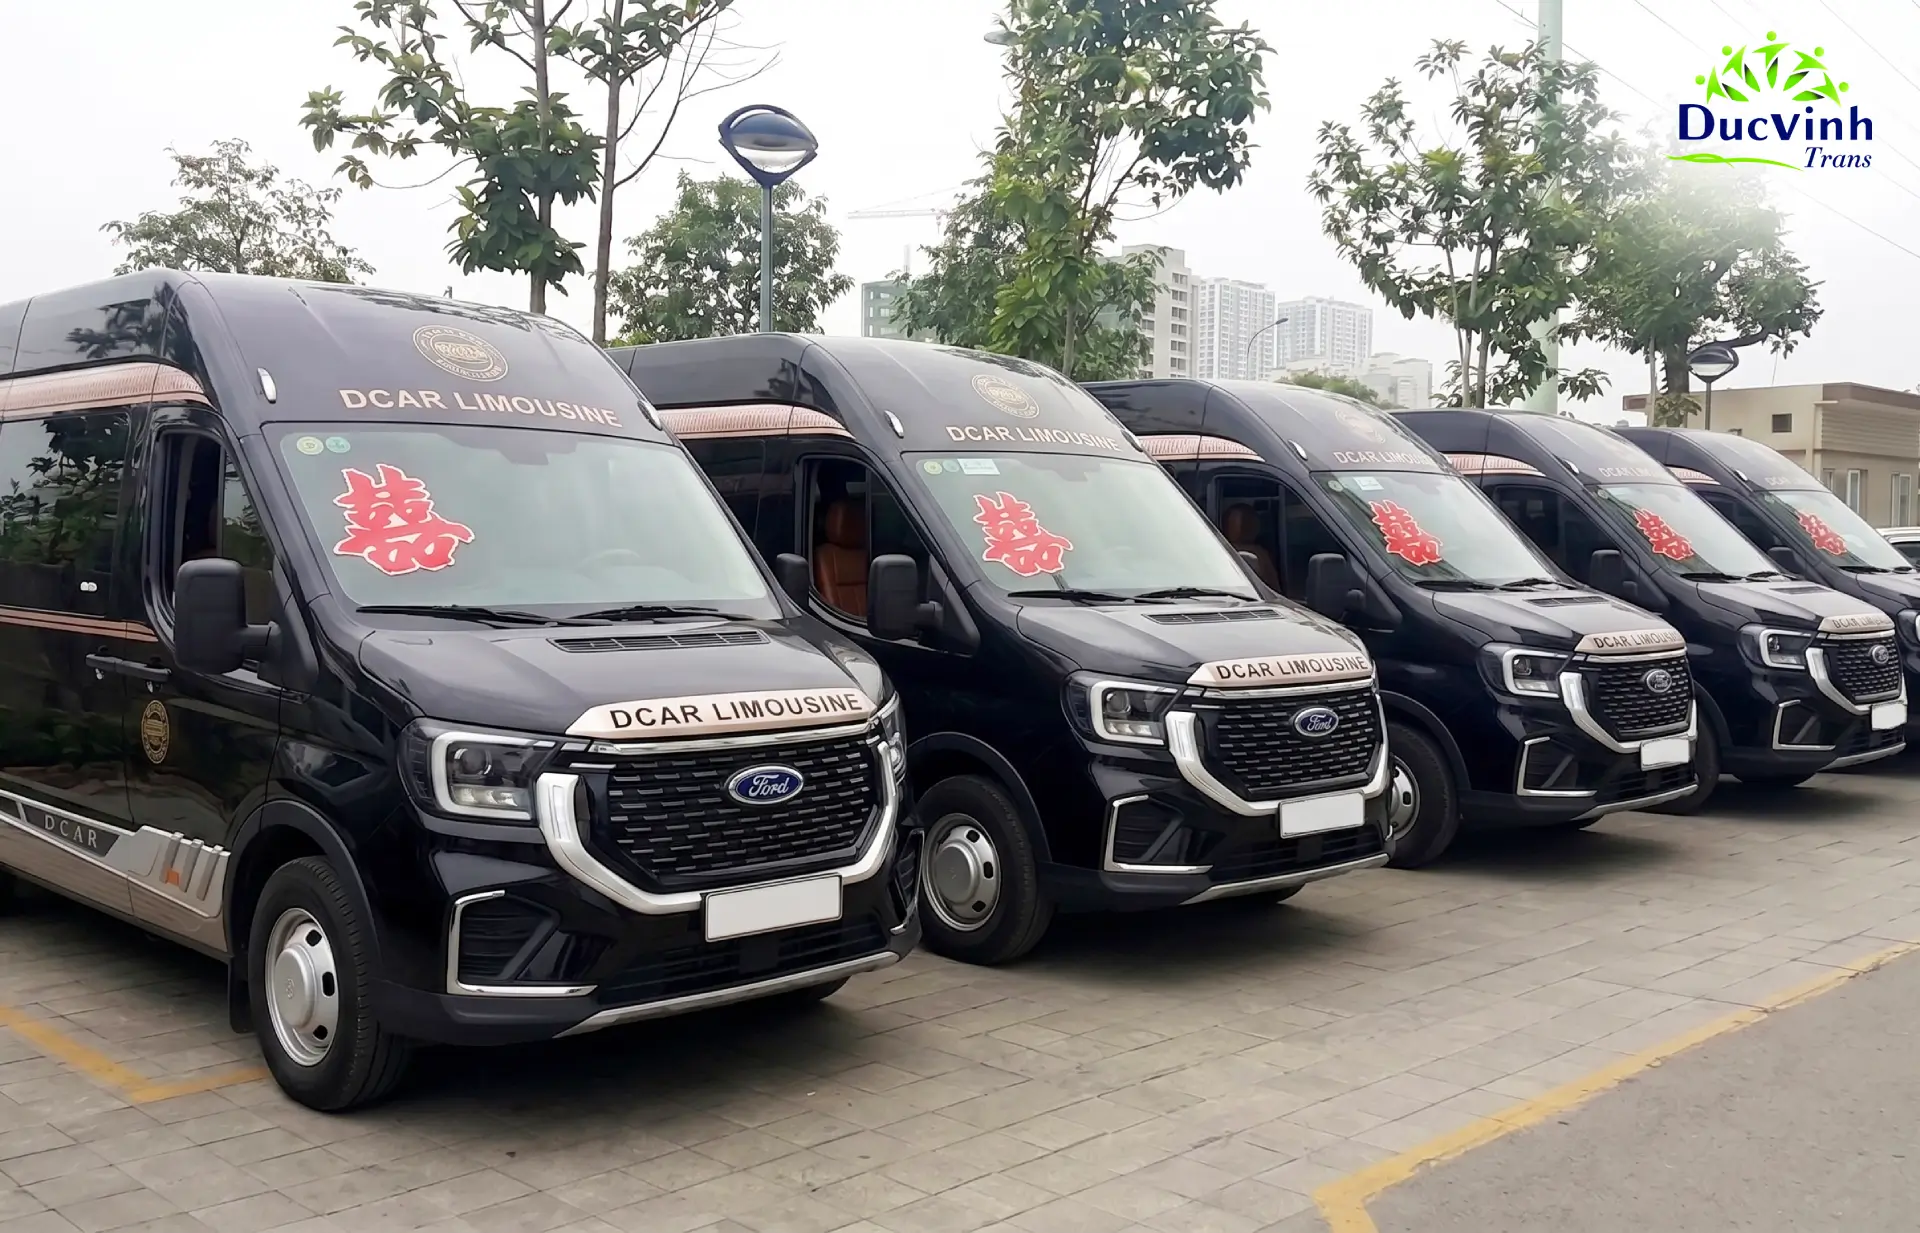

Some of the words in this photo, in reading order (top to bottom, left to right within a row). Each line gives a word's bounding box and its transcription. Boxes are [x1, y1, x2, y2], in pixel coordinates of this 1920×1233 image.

[339, 388, 449, 410] DCAR
[453, 391, 624, 428] LIMOUSINE
[945, 426, 1015, 442] DCAR
[1015, 427, 1122, 452] LIMOUSINE
[1333, 451, 1381, 464] DCAR
[1380, 452, 1437, 466] LIMOU
[1593, 635, 1632, 648] DCAR
[1630, 631, 1679, 646] LIMOU
[1216, 661, 1275, 680] DCAR
[1276, 656, 1368, 675] LIMOUSINE
[609, 704, 703, 729] DCAR
[711, 693, 863, 721] LIMOUSINE
[748, 773, 789, 797] Ford
[44, 814, 97, 848] DCAR
